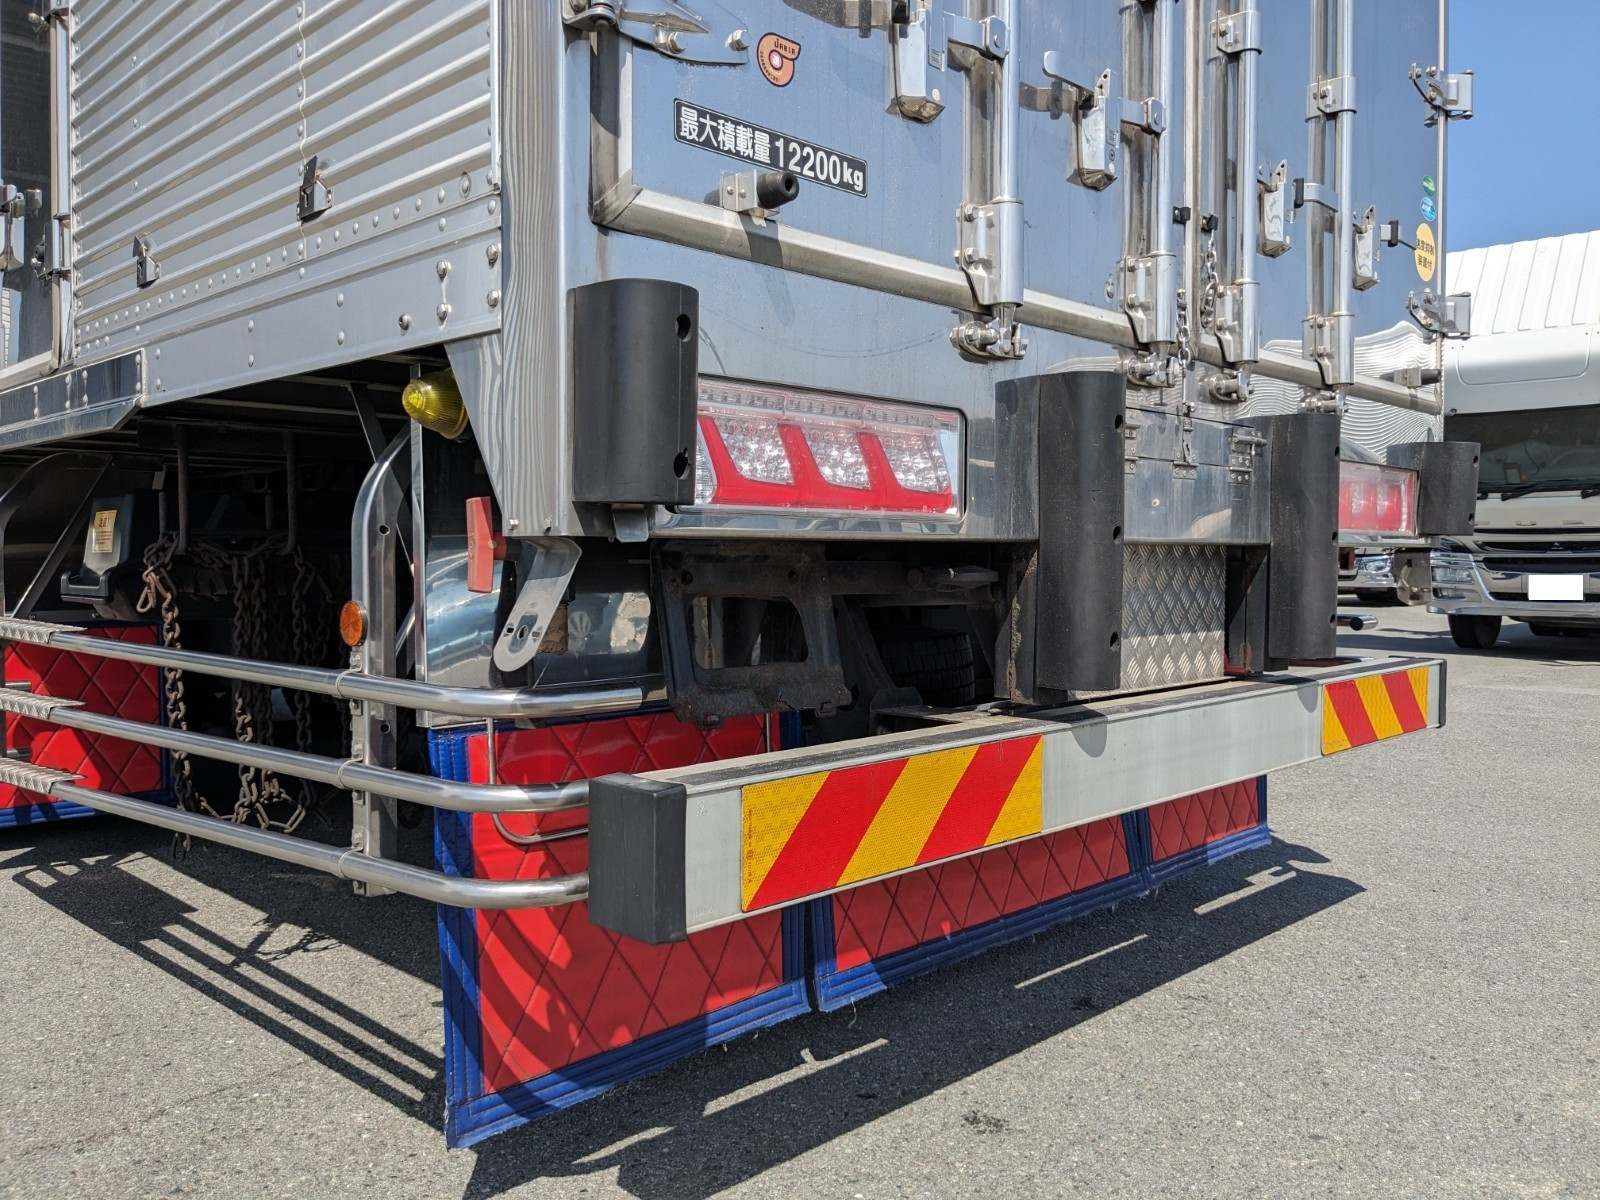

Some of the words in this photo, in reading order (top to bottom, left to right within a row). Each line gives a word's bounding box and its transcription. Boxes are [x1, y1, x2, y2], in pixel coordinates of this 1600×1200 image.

[680, 106, 771, 164] 最大積載量
[775, 137, 864, 191] 12200kg
